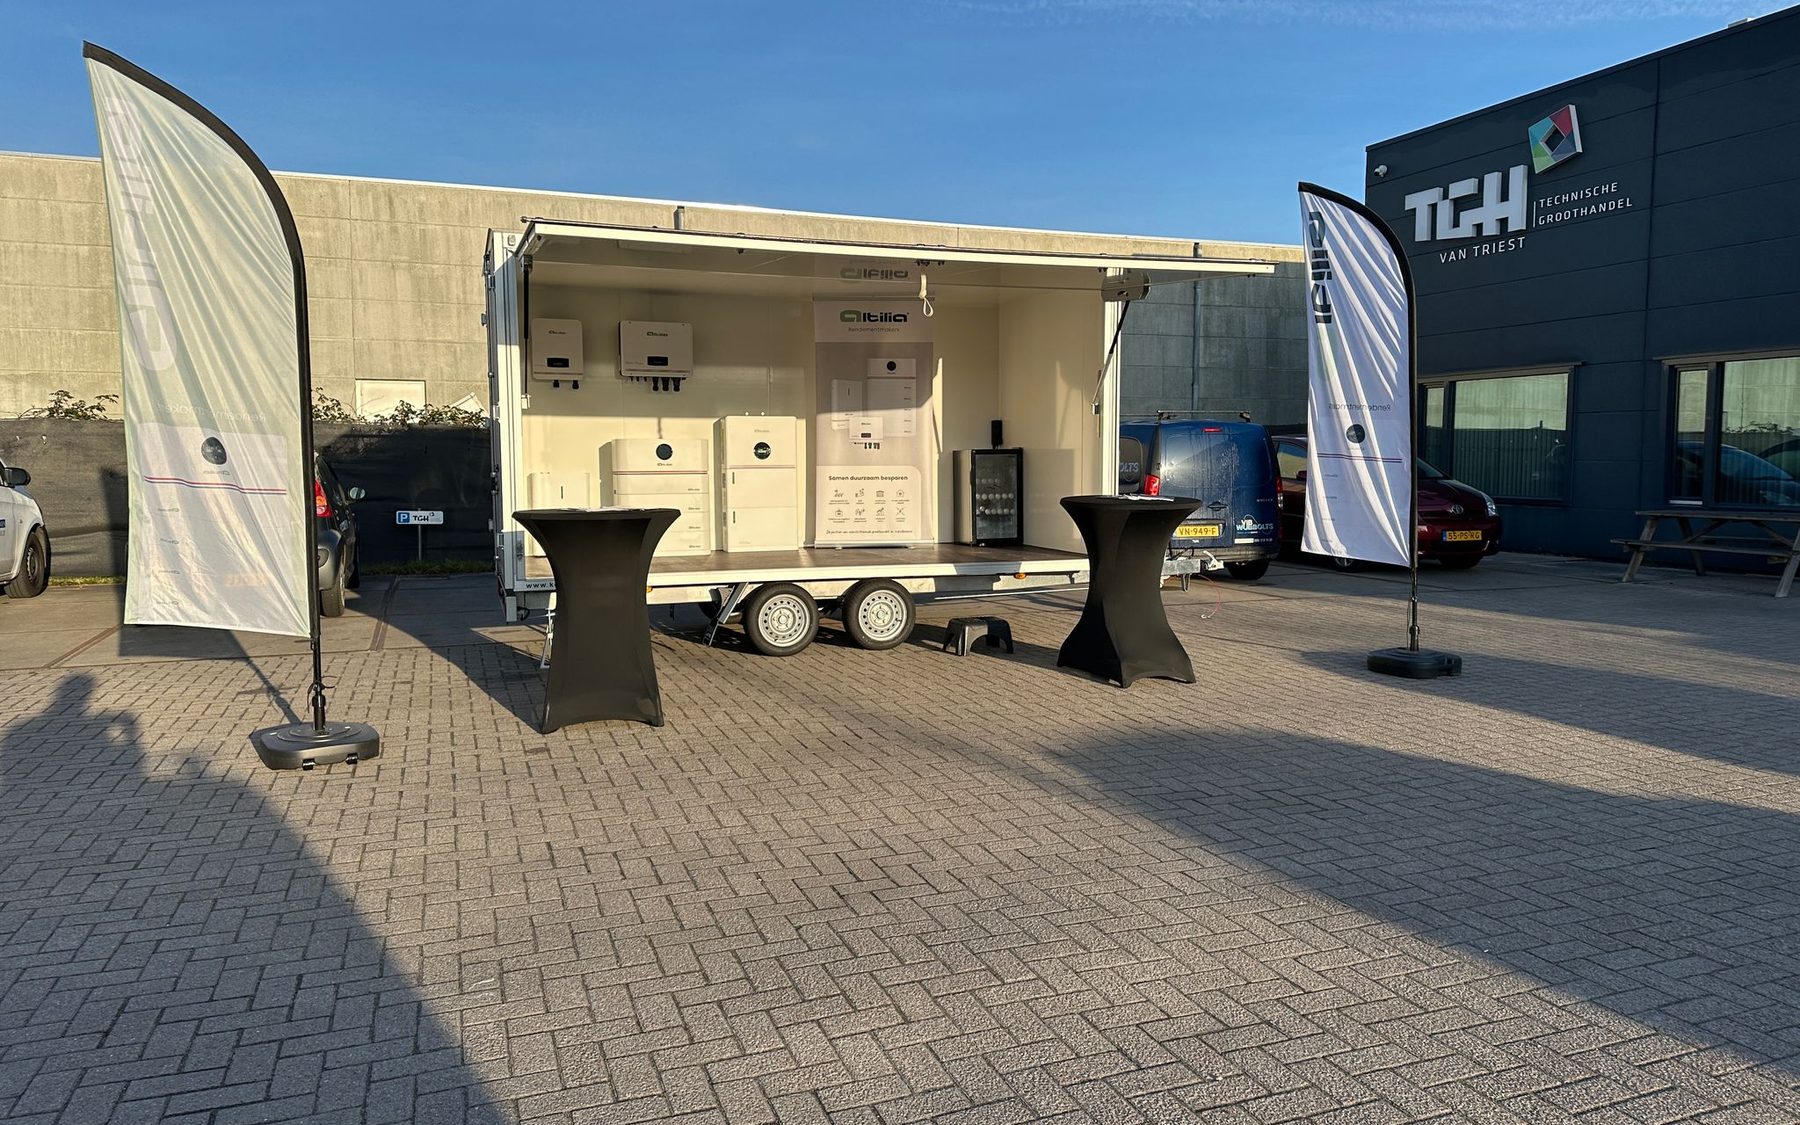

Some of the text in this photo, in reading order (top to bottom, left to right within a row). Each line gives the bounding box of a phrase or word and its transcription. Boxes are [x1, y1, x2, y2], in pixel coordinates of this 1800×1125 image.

[1404, 164, 1528, 242] TGH
[1538, 182, 1619, 208] TECHNISCHE
[1538, 197, 1633, 226] GROOTHANDEL
[1439, 236, 1527, 264] VAN TRIEST
